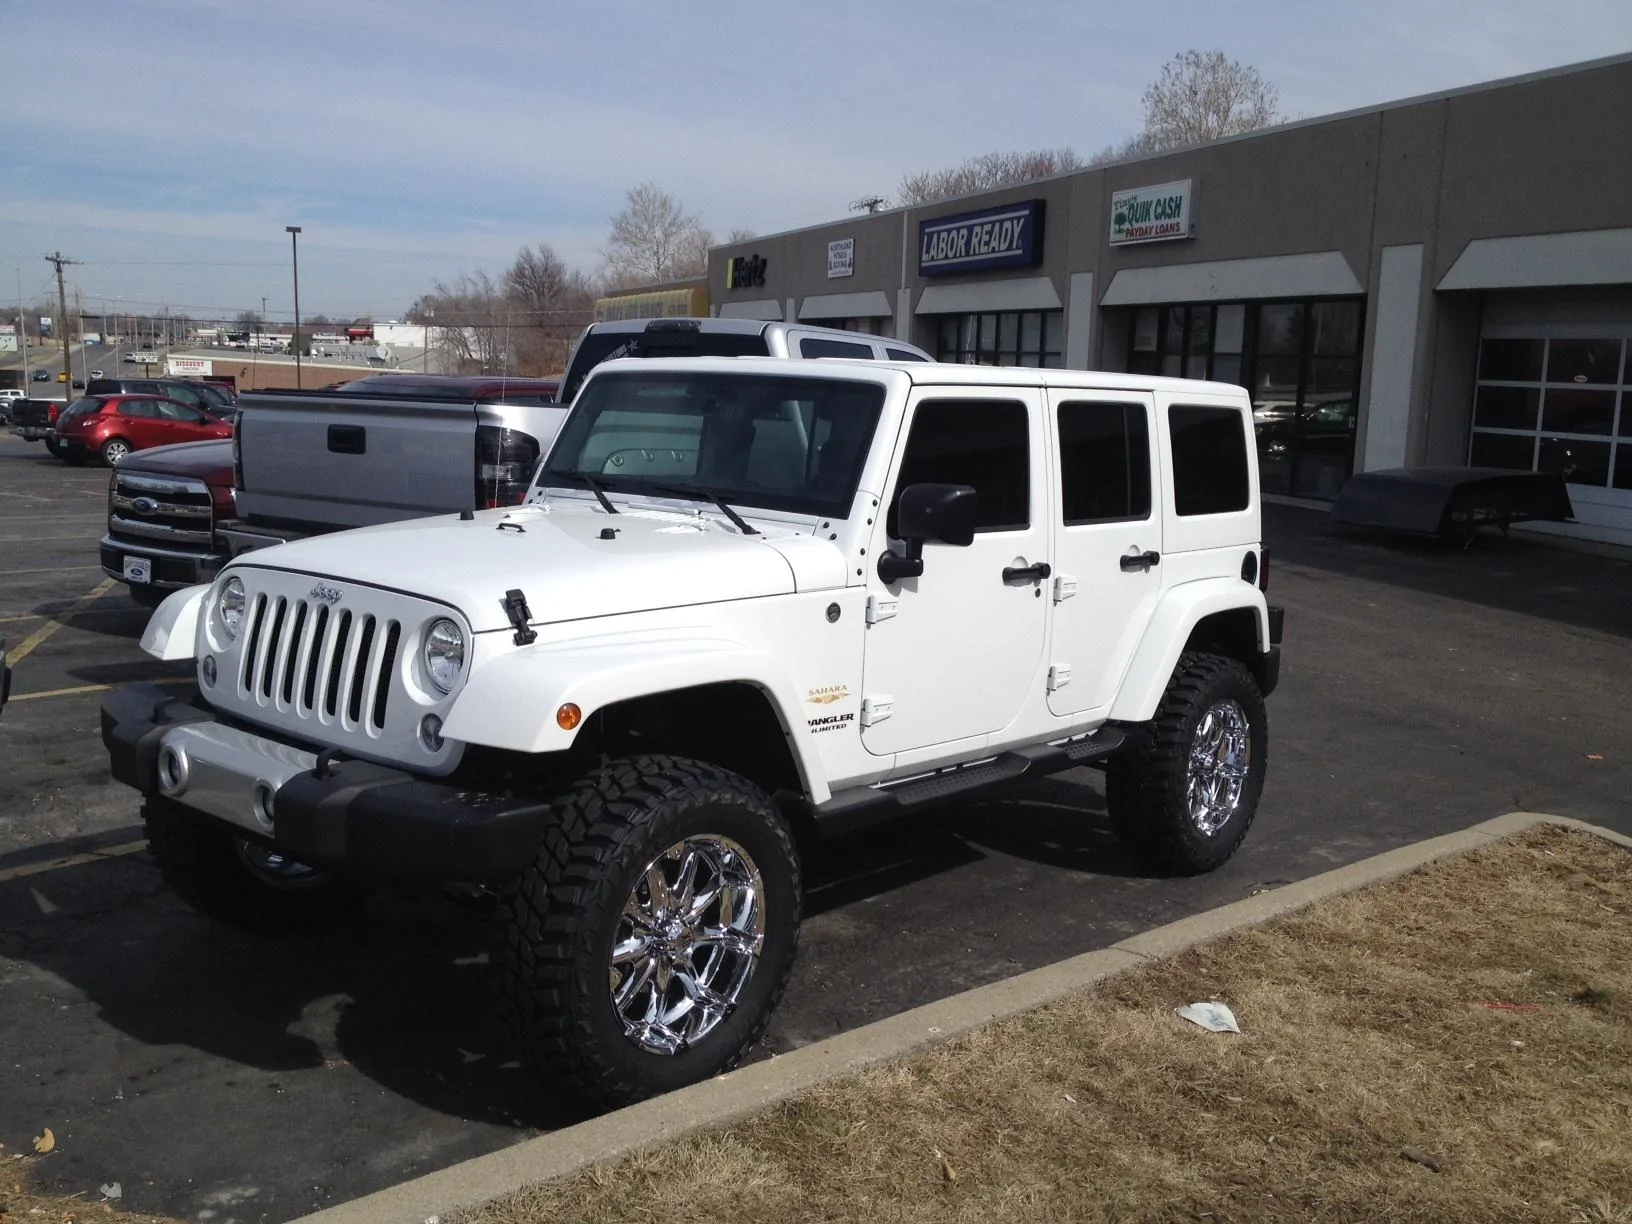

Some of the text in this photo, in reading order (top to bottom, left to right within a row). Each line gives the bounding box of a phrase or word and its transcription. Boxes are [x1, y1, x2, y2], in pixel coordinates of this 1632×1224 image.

[1127, 195, 1182, 227] QUIK CASH
[922, 218, 1024, 262] LABOR READY
[1125, 221, 1181, 239] PAYDAY LOANS
[310, 581, 343, 606] Jeep
[808, 684, 848, 697] SAHARA
[808, 712, 854, 726] ANGLER
